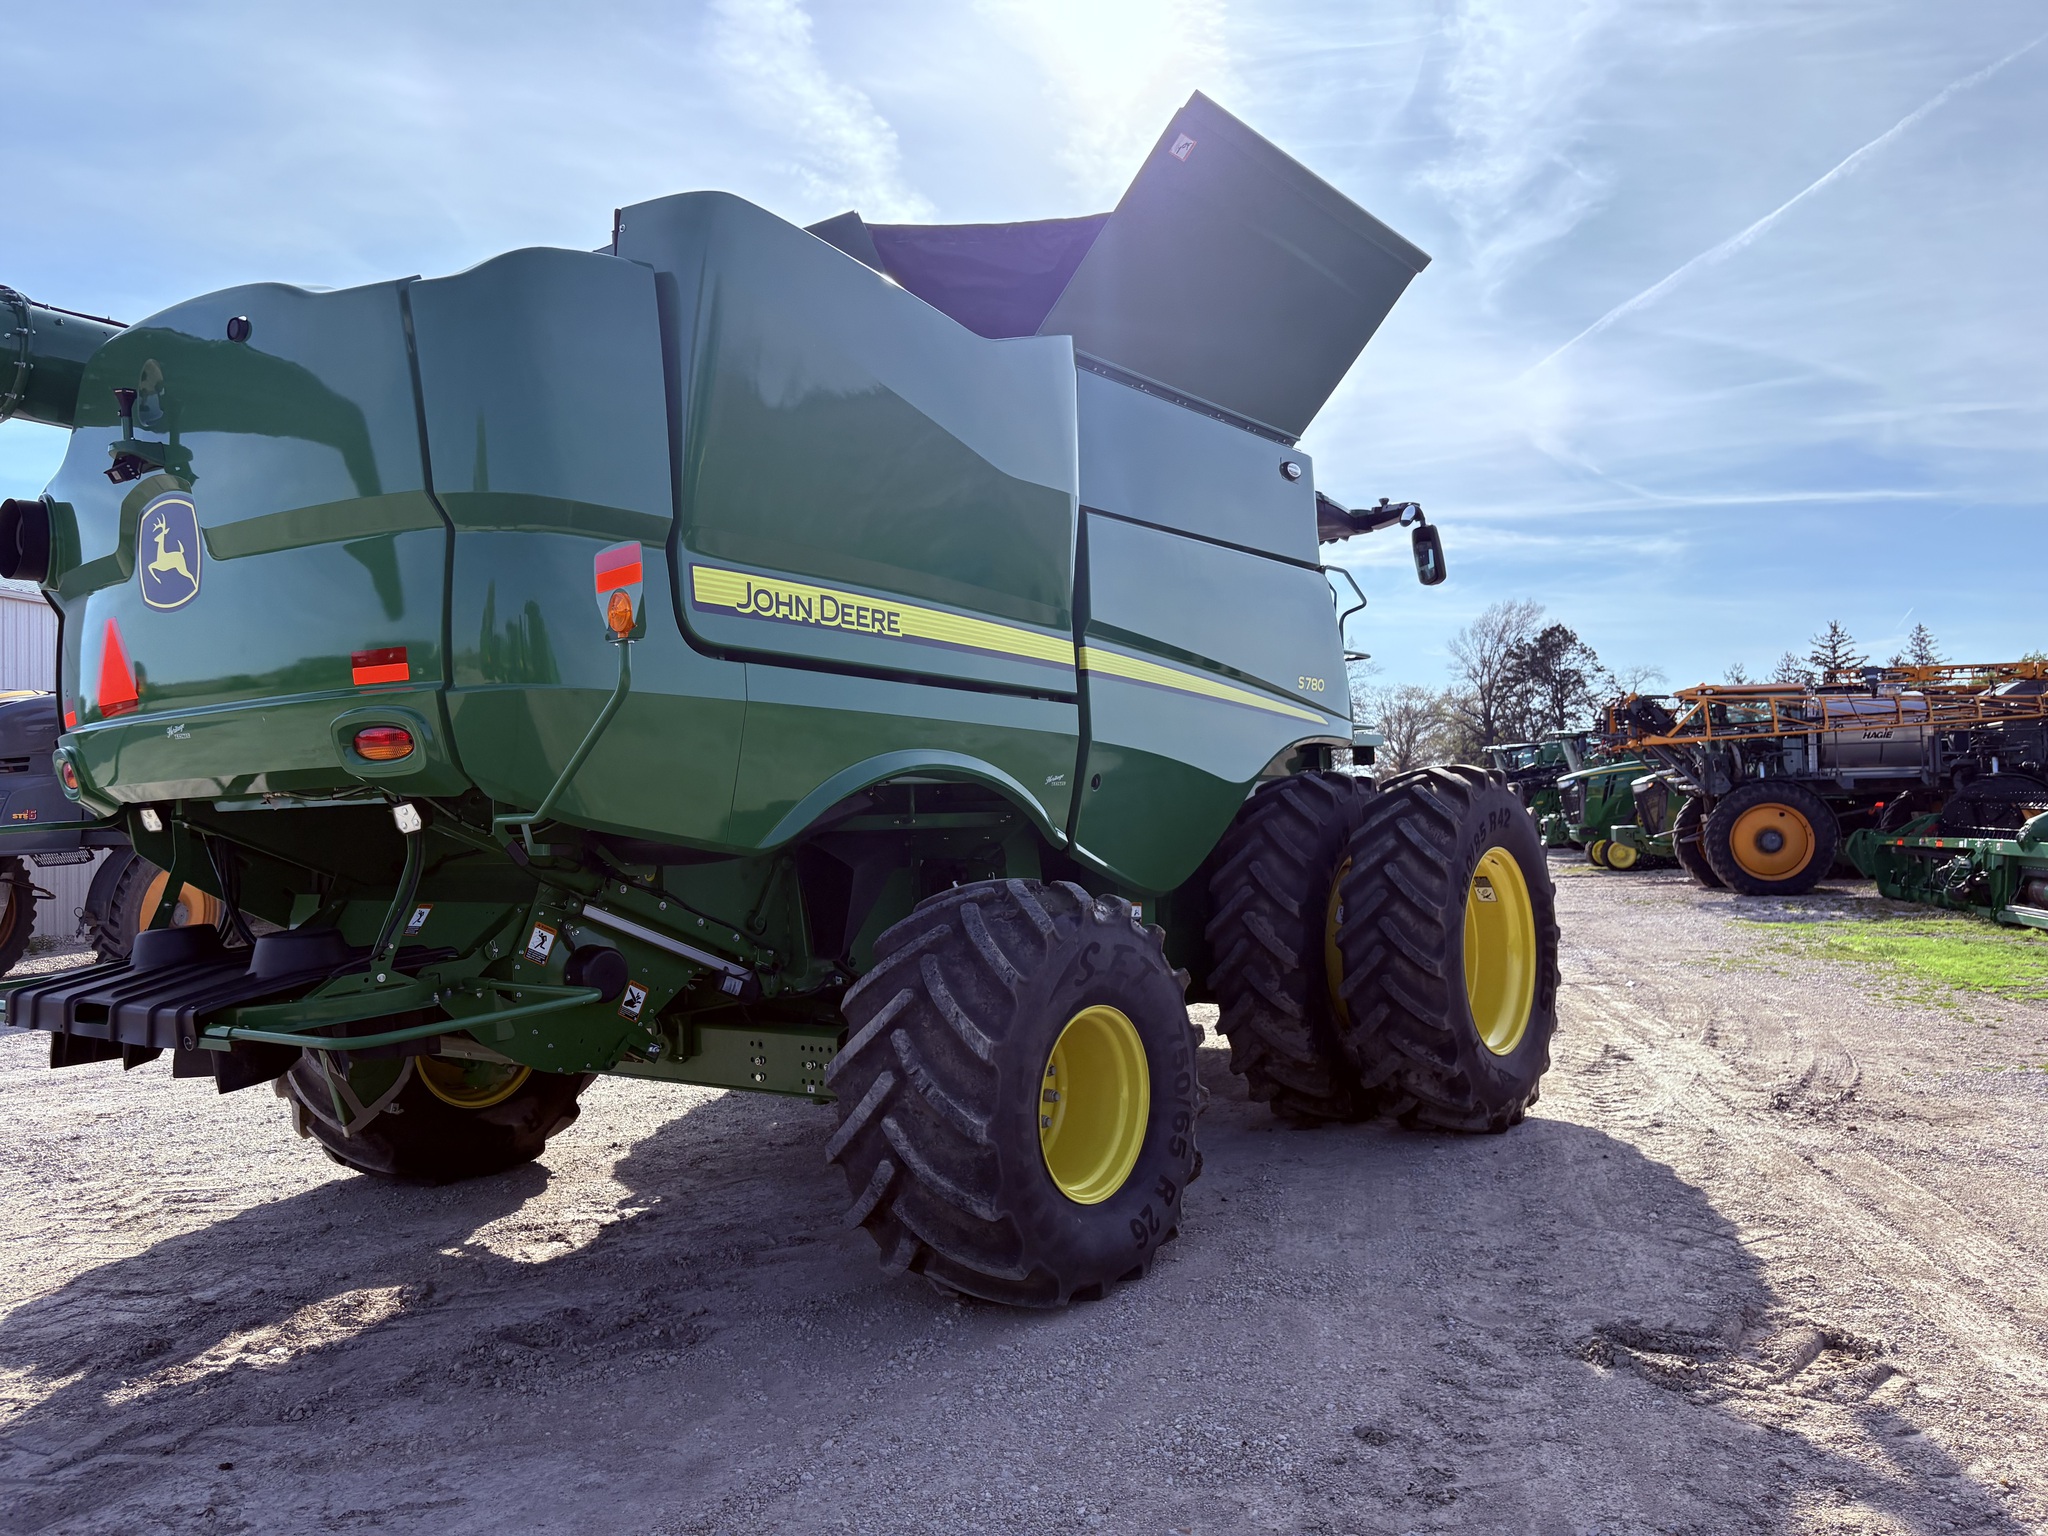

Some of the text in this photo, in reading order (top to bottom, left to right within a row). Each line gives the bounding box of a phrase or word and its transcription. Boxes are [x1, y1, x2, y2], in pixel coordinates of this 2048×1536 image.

[736, 581, 902, 635] JOHN DEERE
[1298, 676, 1325, 692] S780
[1862, 731, 1894, 739] HAGIE
[1489, 807, 1511, 833] R42
[1129, 1017, 1193, 1250] 750/65 R 26
